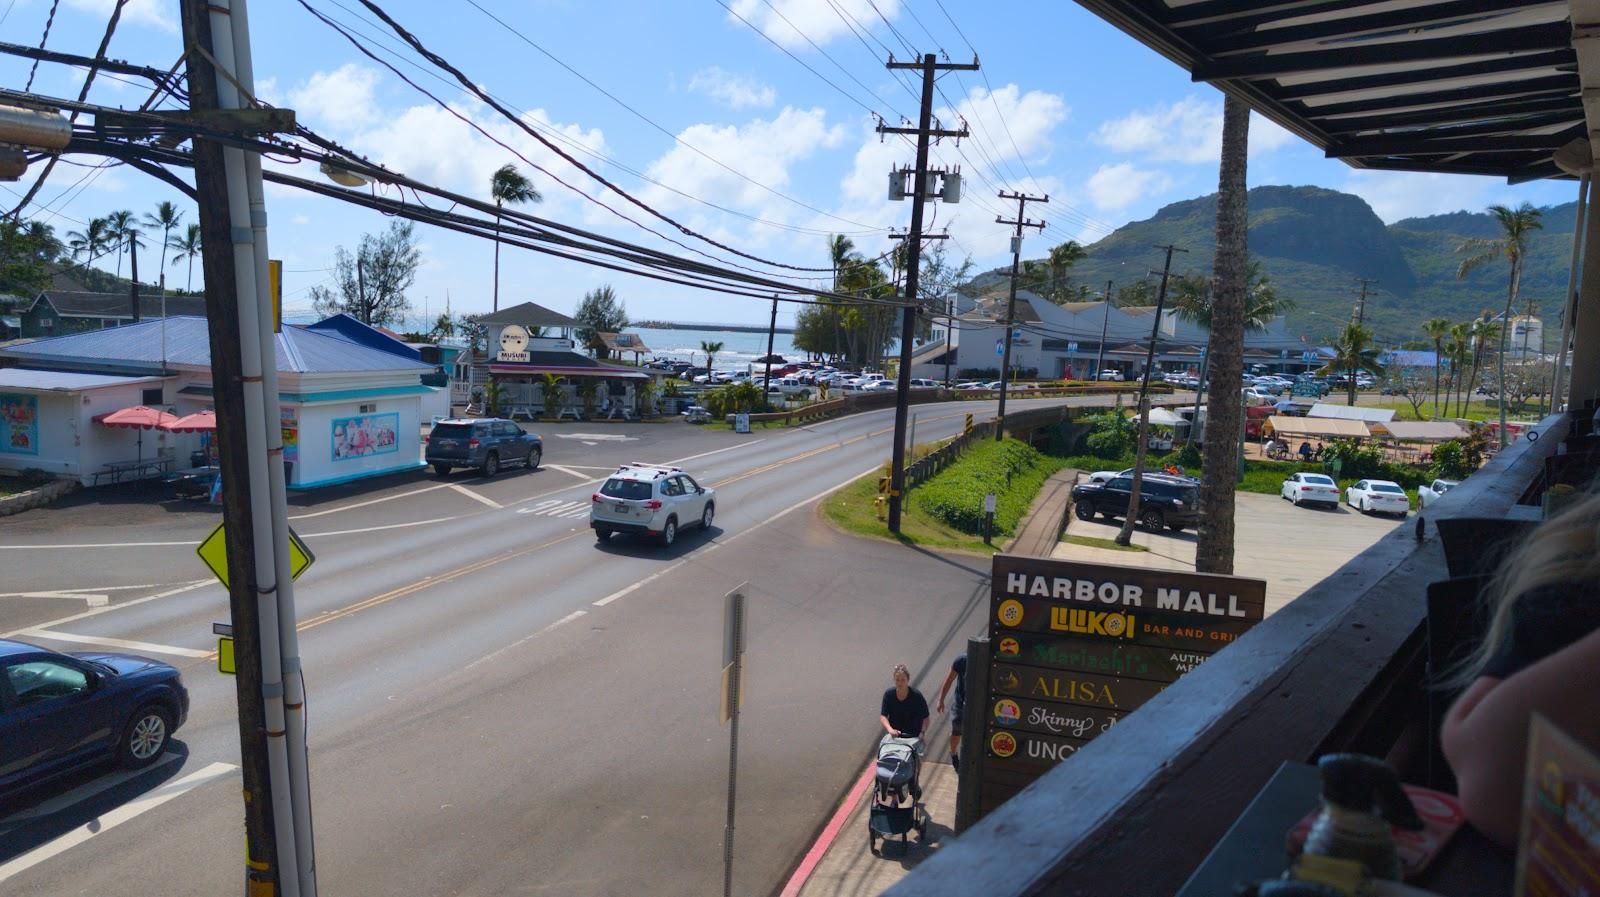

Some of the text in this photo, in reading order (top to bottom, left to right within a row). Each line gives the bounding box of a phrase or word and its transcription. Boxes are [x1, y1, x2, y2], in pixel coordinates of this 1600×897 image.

[1007, 573, 1246, 617] HARBOR MALL
[1143, 624, 1169, 635] BAR
[1175, 629, 1203, 639] AND
[1032, 677, 1115, 705] ALISA
[1028, 707, 1094, 737] Skinny
